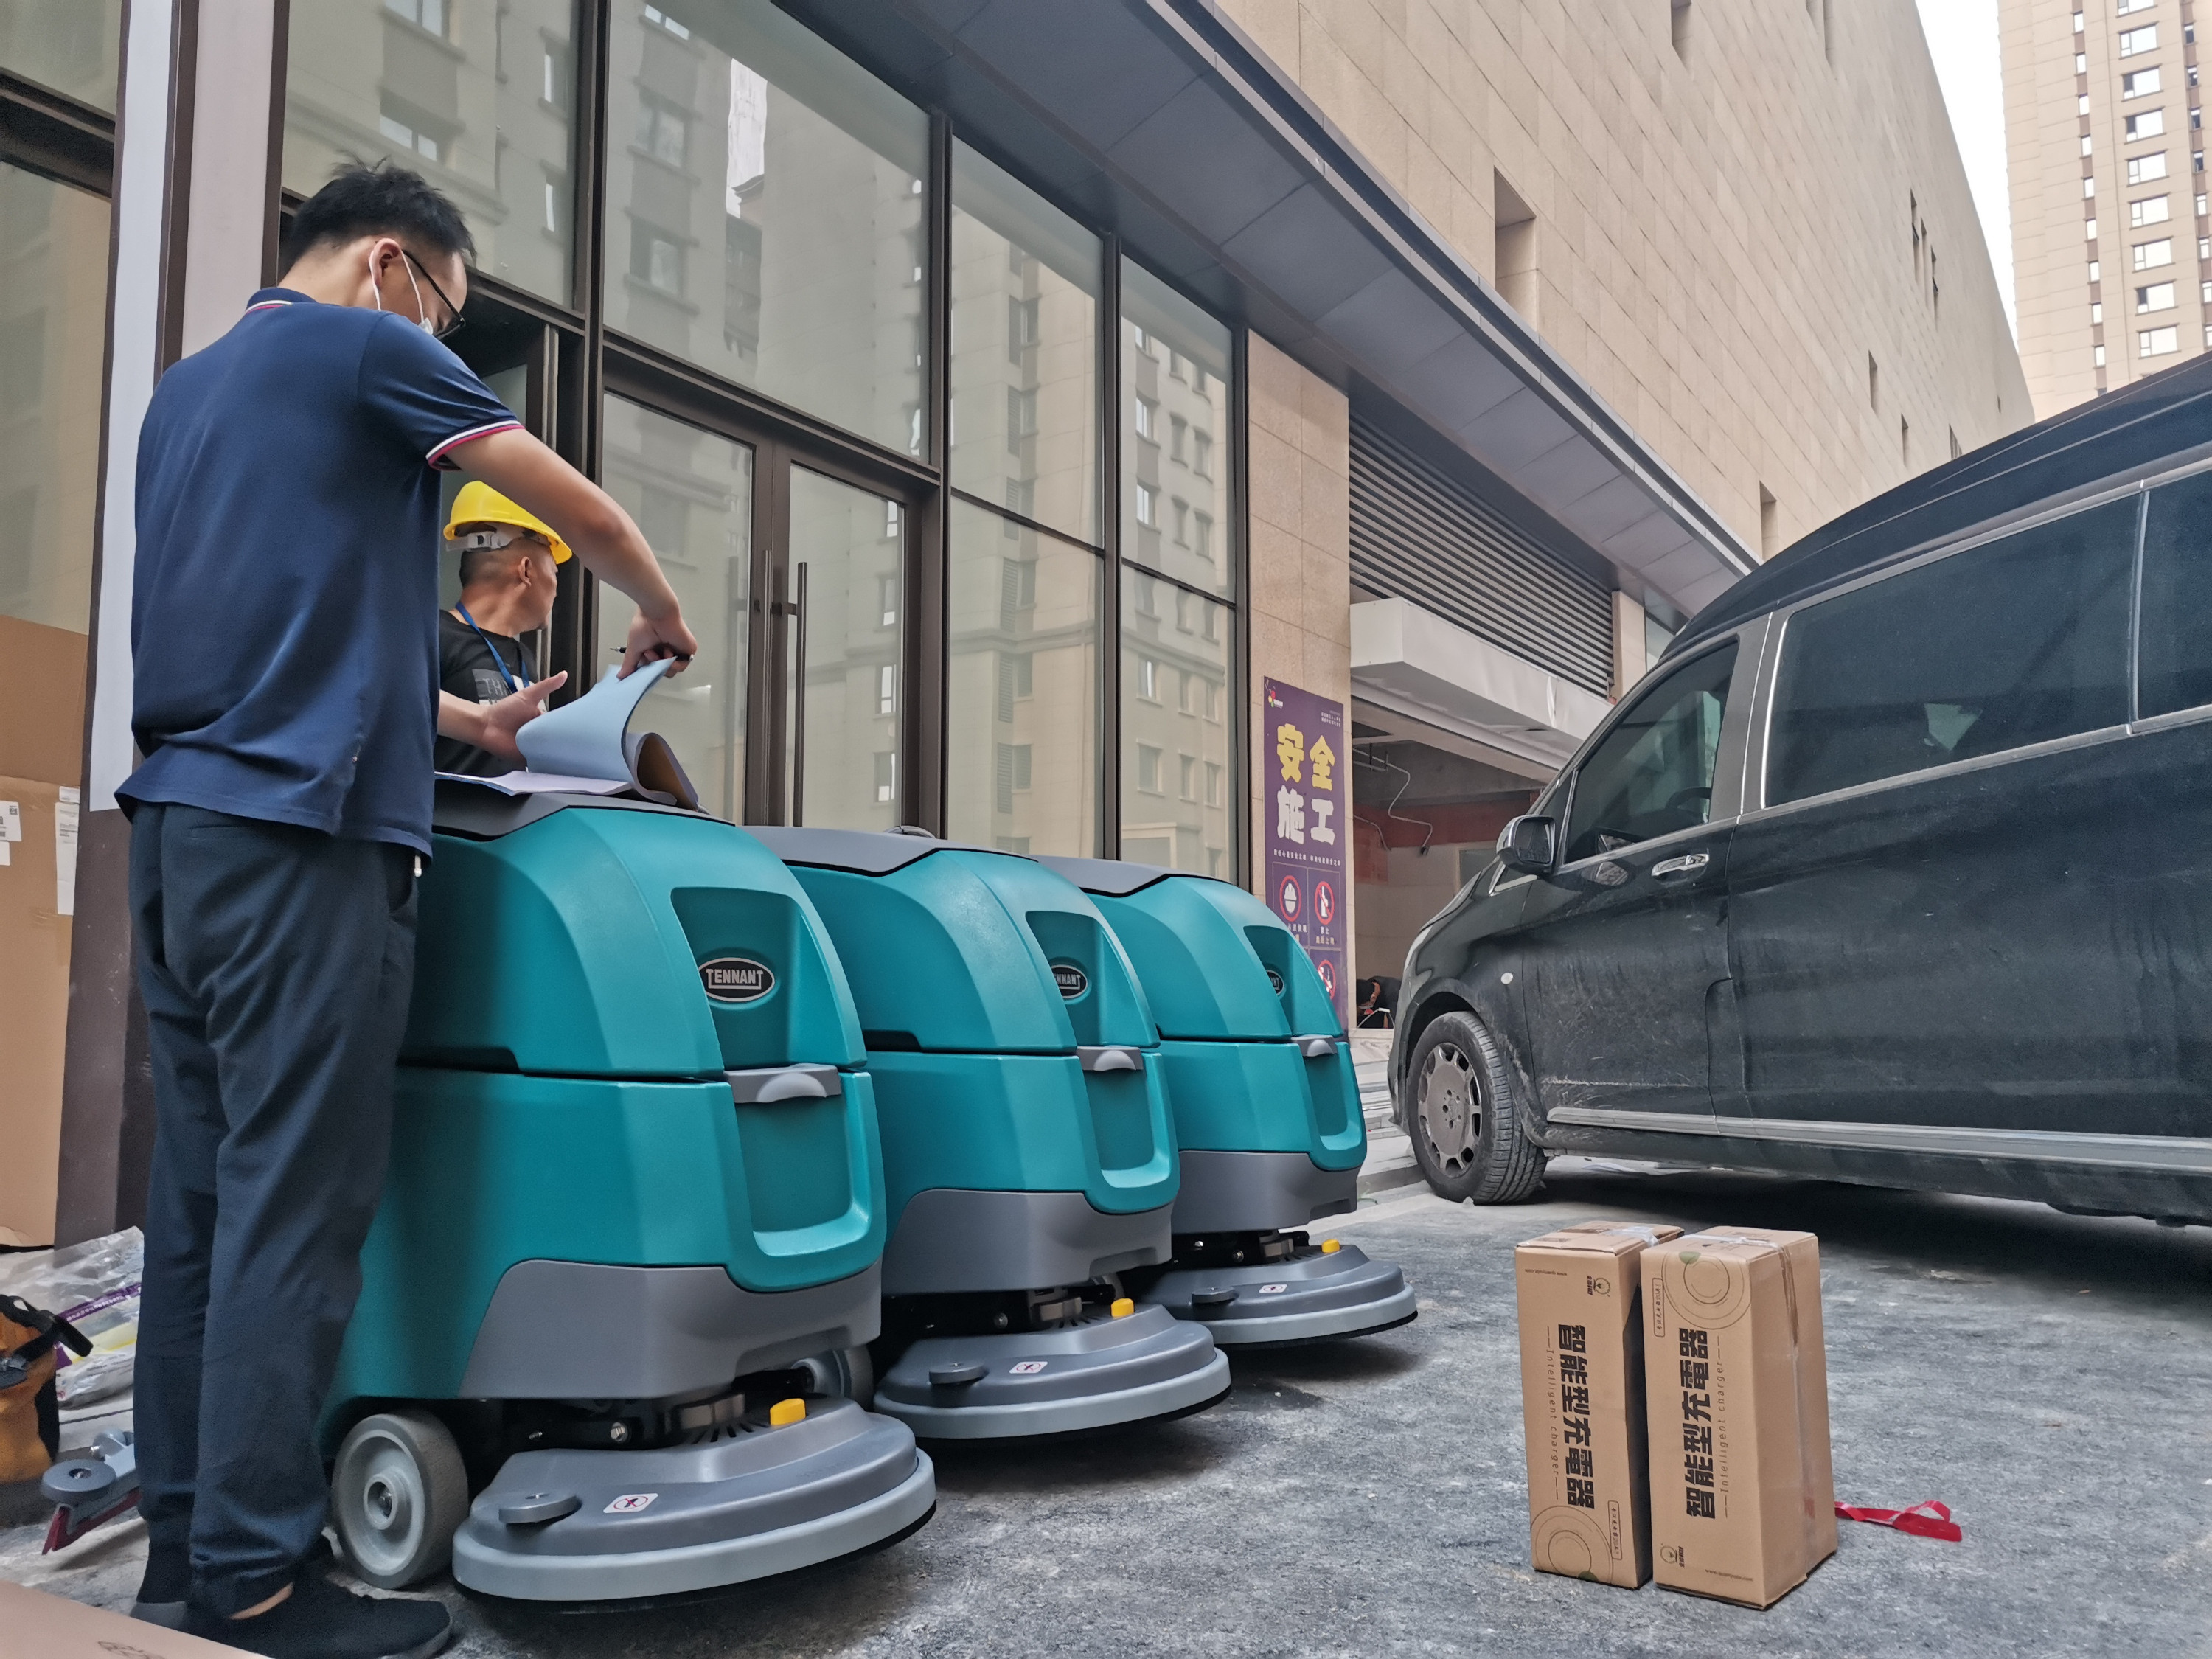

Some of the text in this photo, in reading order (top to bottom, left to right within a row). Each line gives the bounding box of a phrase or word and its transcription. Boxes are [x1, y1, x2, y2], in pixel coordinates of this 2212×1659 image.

[1276, 723, 1335, 791] 安全
[1276, 785, 1336, 846] 施工
[706, 968, 764, 990] TENNANT
[1054, 973, 1081, 990] NNANT
[1546, 1349, 1559, 1475] Intelligent charger
[1558, 1324, 1595, 1509] 智能型充電器
[1679, 1328, 1716, 1519] 智能型充電器
[1715, 1360, 1729, 1494] Intelligent charger
